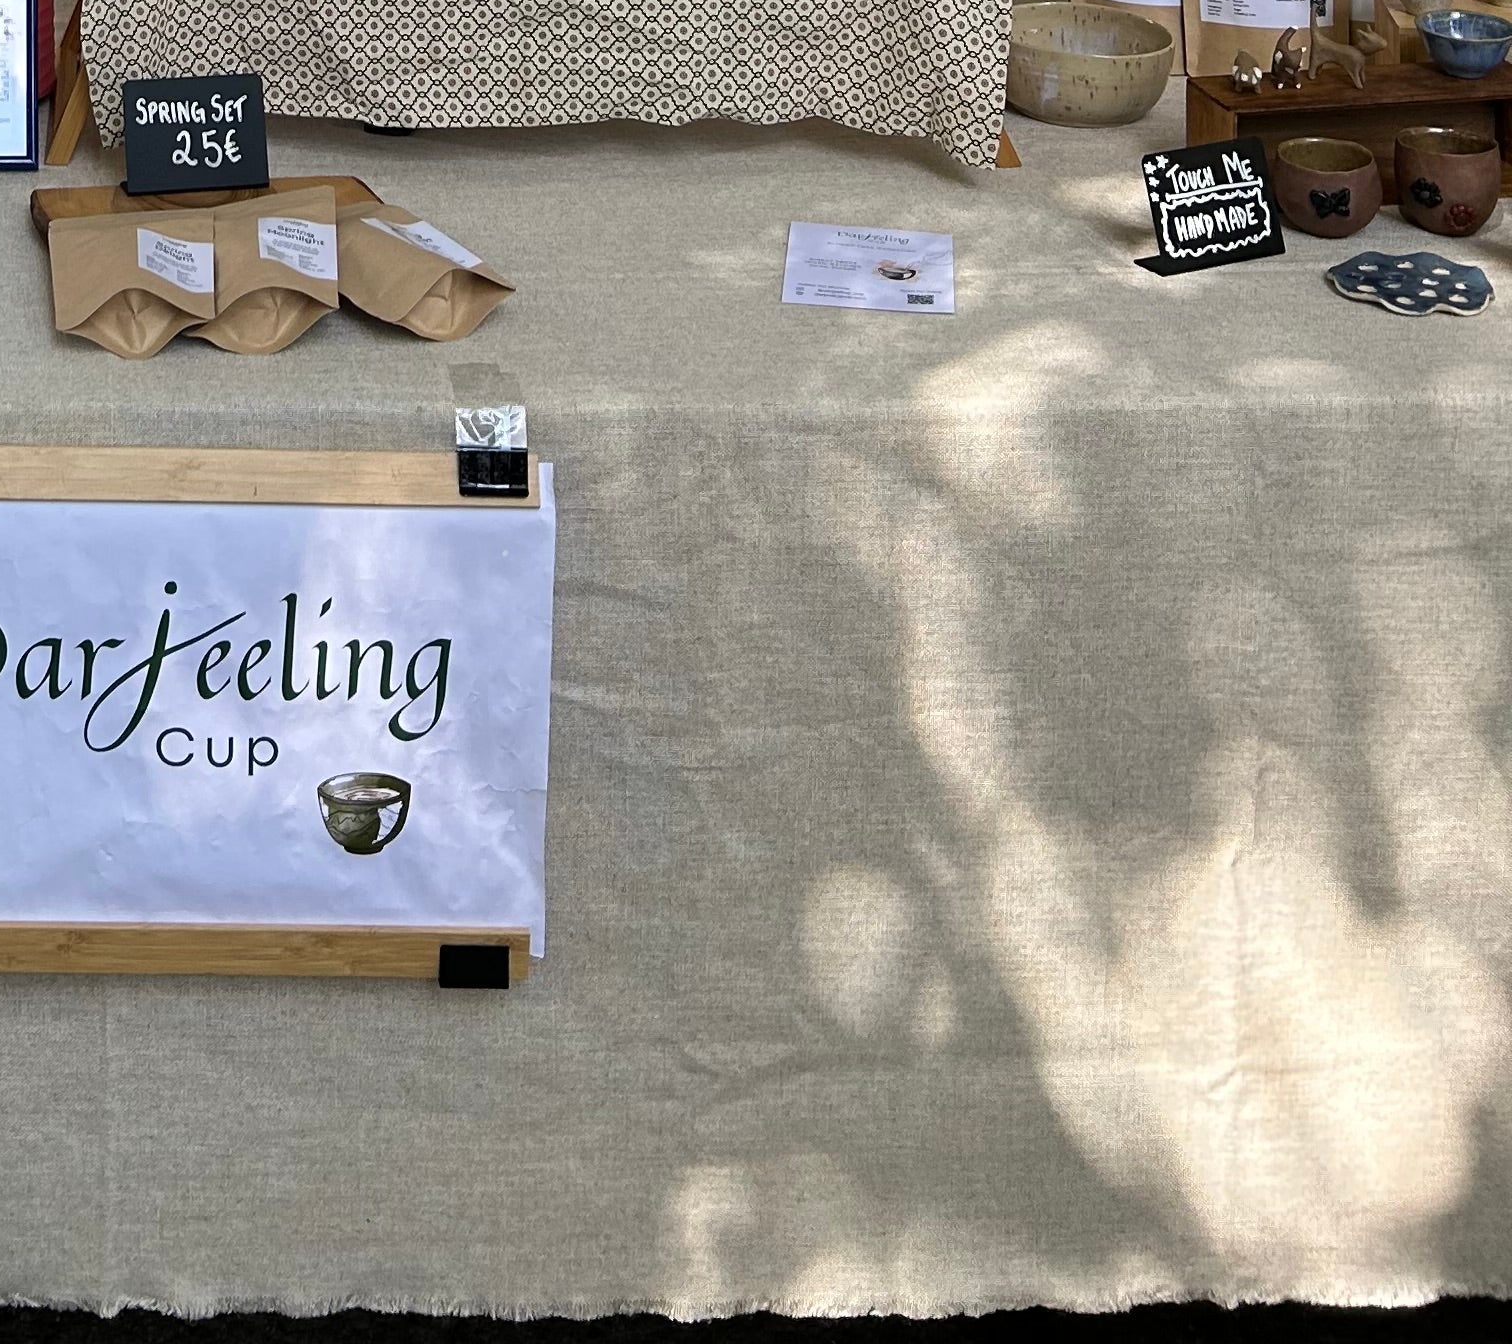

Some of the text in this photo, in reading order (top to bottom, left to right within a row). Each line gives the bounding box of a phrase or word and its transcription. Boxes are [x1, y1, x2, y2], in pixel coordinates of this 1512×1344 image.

[135, 93, 248, 125] SPRING SET
[1165, 151, 1255, 194] TOUCH ME
[154, 726, 281, 776] Cup
